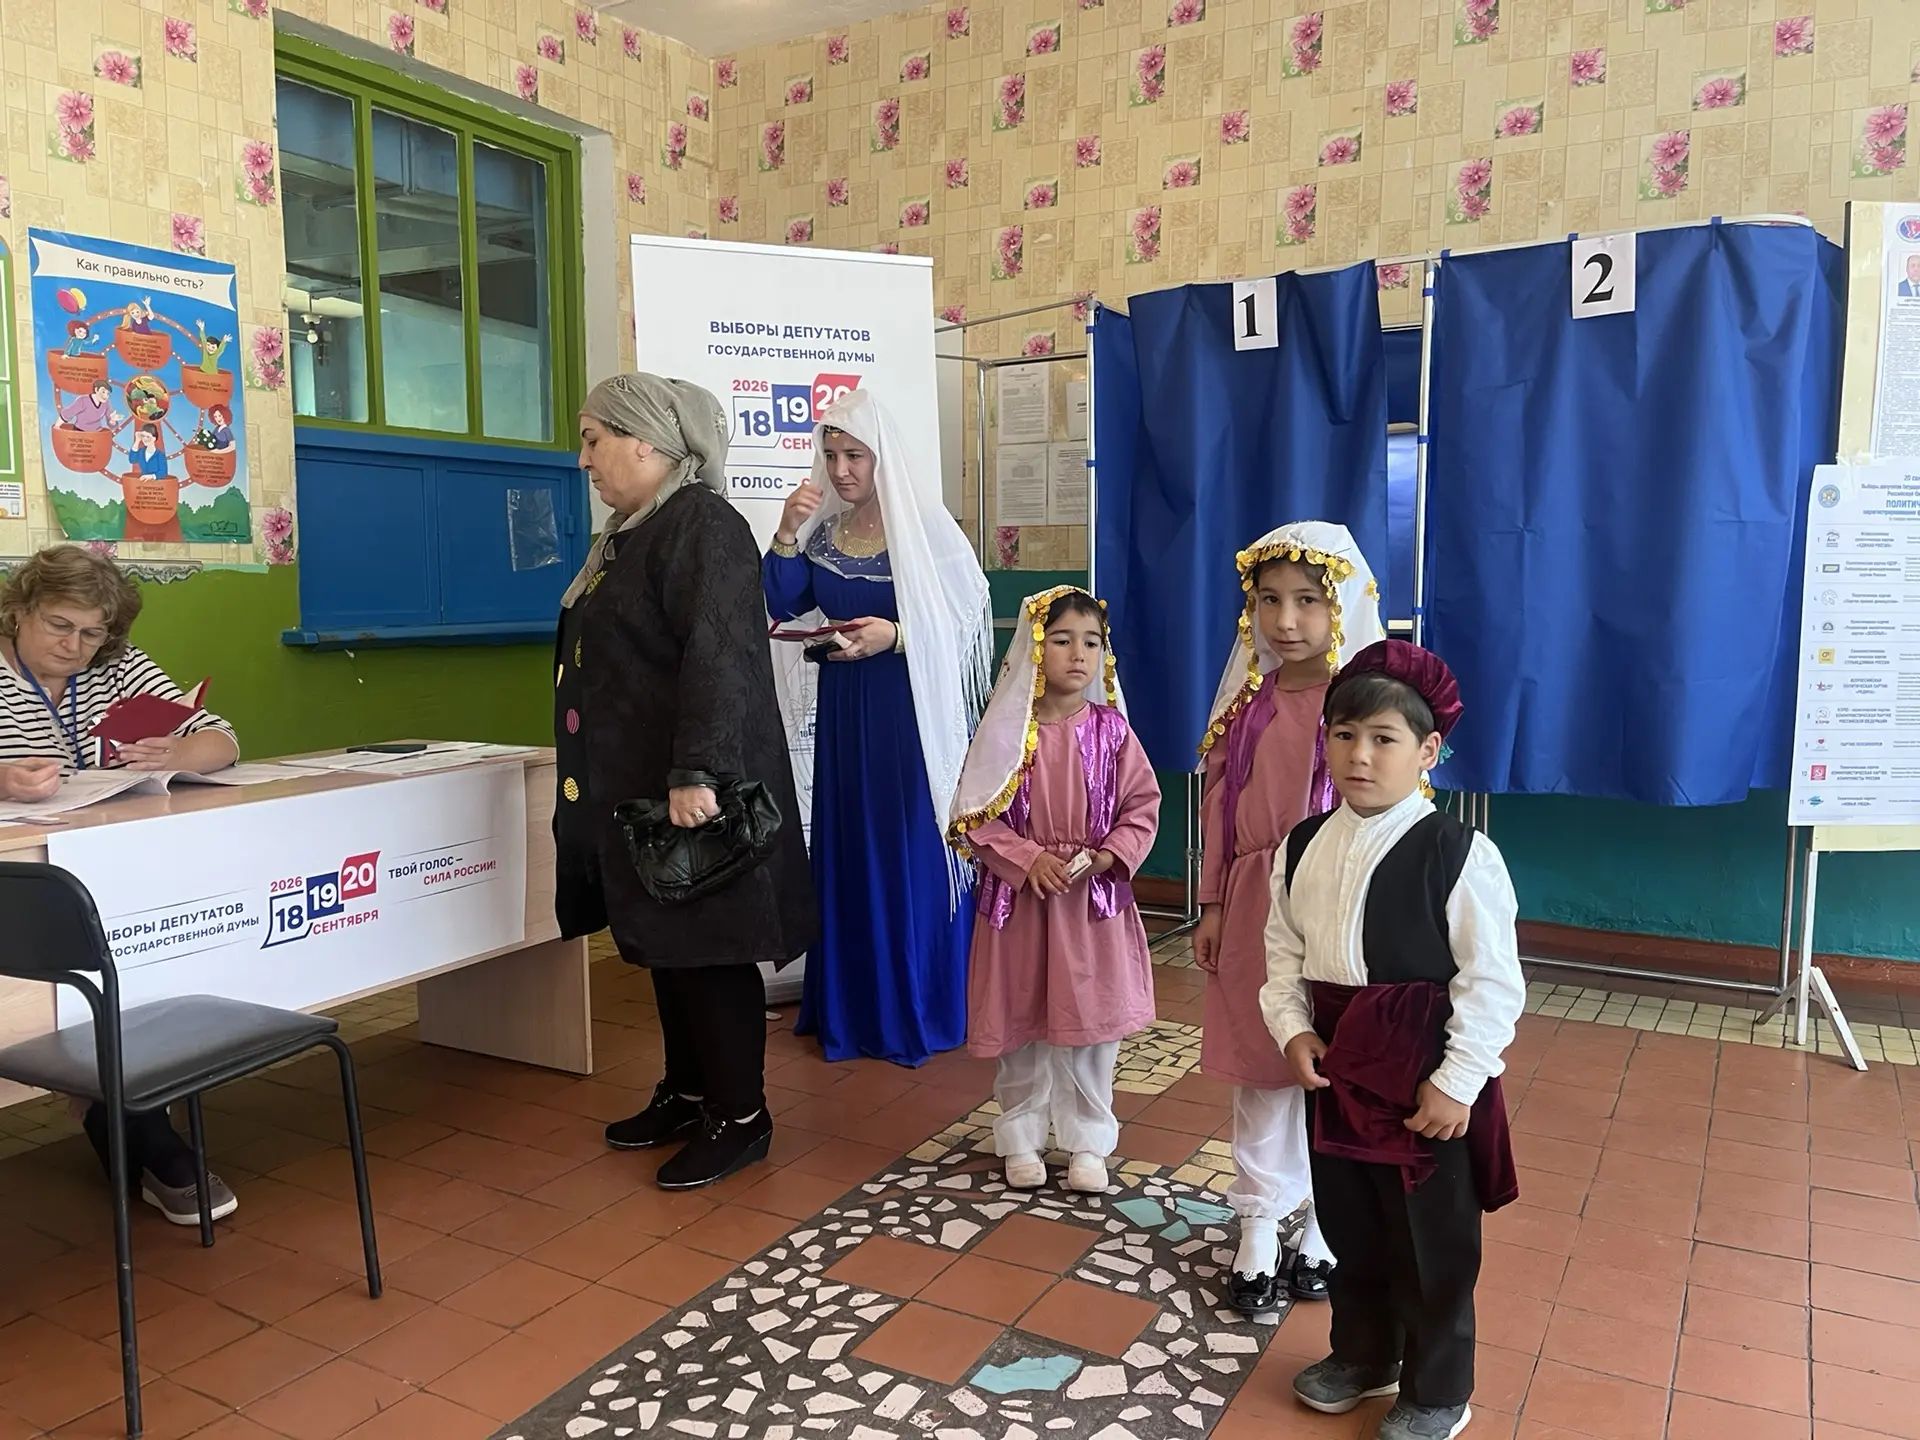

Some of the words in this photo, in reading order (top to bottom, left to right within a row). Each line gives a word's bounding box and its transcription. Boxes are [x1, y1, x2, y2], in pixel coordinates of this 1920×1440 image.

[76, 258, 99, 272] Как
[104, 264, 170, 284] правильно
[173, 276, 204, 290] есть?
[1582, 253, 1615, 304] 2
[1239, 293, 1262, 338] 1
[710, 321, 779, 337] ВЫБОРЫ
[783, 325, 871, 341] ДЕПУТАТОВ
[708, 344, 834, 360] ГОСУДАРСТВЕННОЙ
[838, 351, 875, 363] ДУМЫ
[732, 379, 769, 392] 2026
[739, 409, 772, 436] 18
[776, 396, 809, 423] 19
[732, 476, 783, 489] ГОЛОС
[388, 862, 417, 879] ТВОЙ
[420, 856, 454, 872] ГОЛОС
[423, 872, 452, 885] СИЛА
[454, 860, 497, 878] РОССИИ!
[270, 876, 303, 893] 2026
[275, 905, 304, 933] 18
[309, 882, 337, 911] 19
[343, 862, 375, 892] 20
[159, 902, 244, 932] ДЕПУТАТОВ
[226, 916, 259, 932] ДУМЫ
[313, 909, 379, 935] СЕНТЯБРЯ
